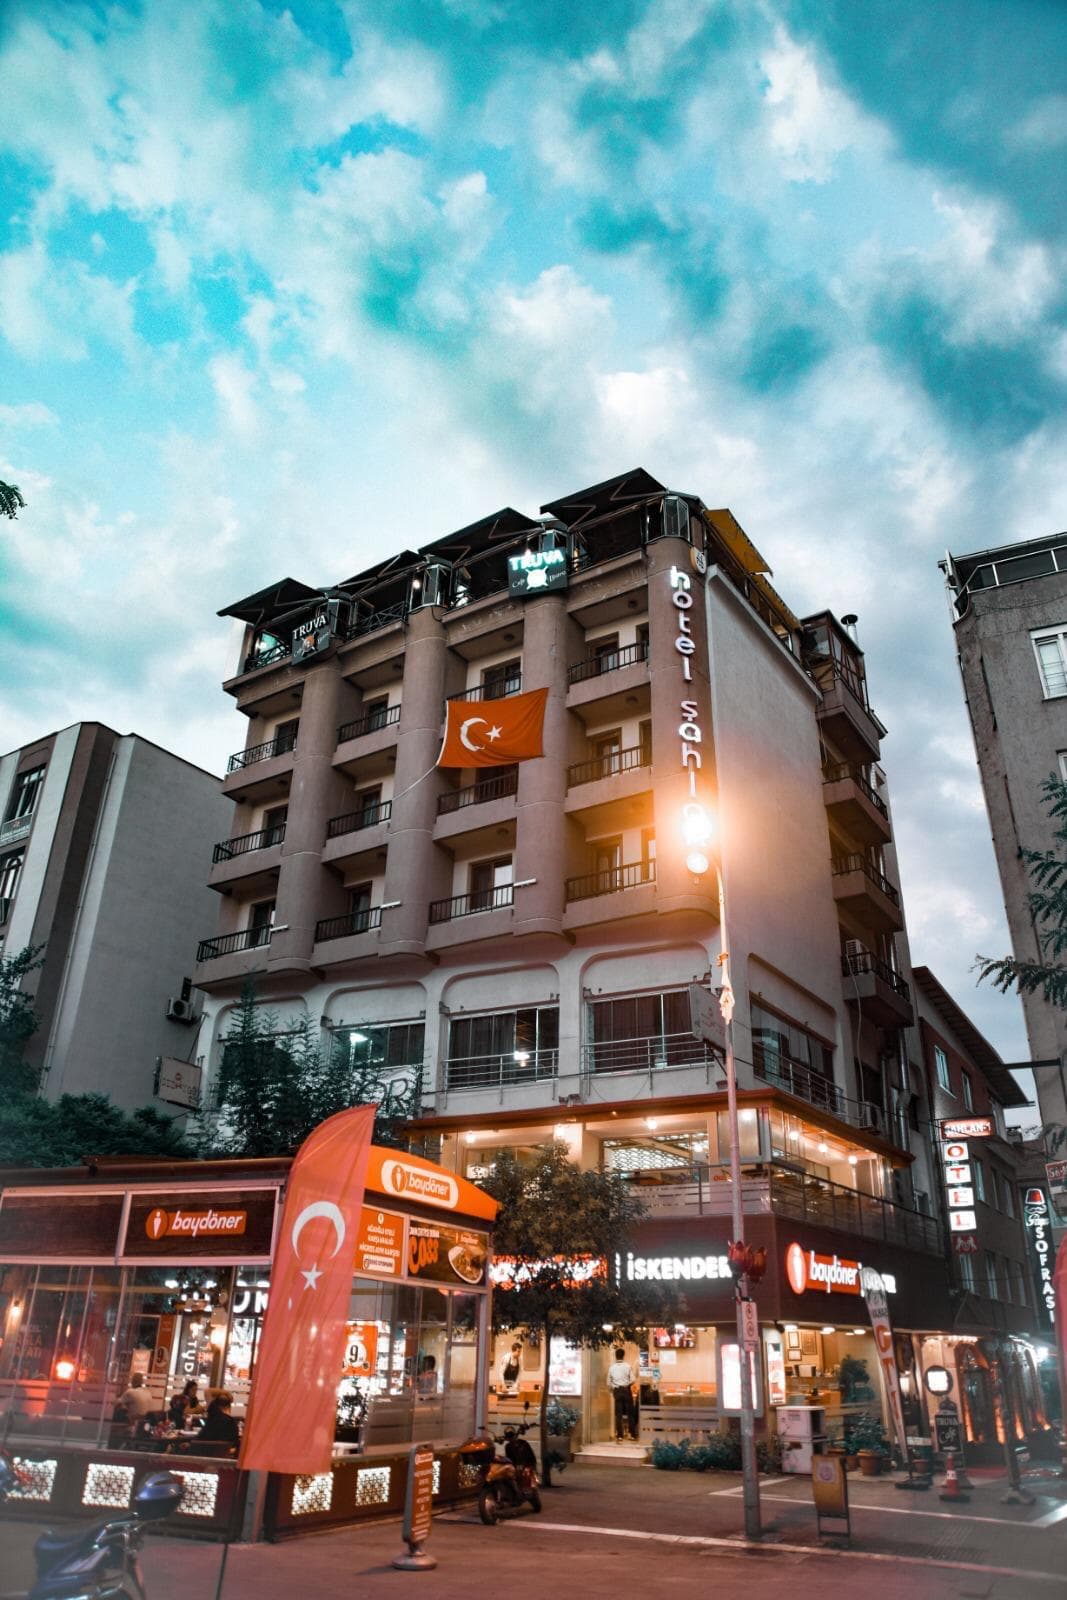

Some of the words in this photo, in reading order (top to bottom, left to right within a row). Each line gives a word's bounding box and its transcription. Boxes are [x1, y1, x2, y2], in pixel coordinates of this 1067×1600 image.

[508, 549, 565, 571] TRUVA
[292, 614, 327, 640] TRUVA
[671, 566, 695, 680] hotel
[408, 1173, 449, 1196] baydöner
[171, 1210, 243, 1237] baydöner
[809, 1250, 859, 1294] baydöner
[1034, 1226, 1056, 1323] SOFRASI
